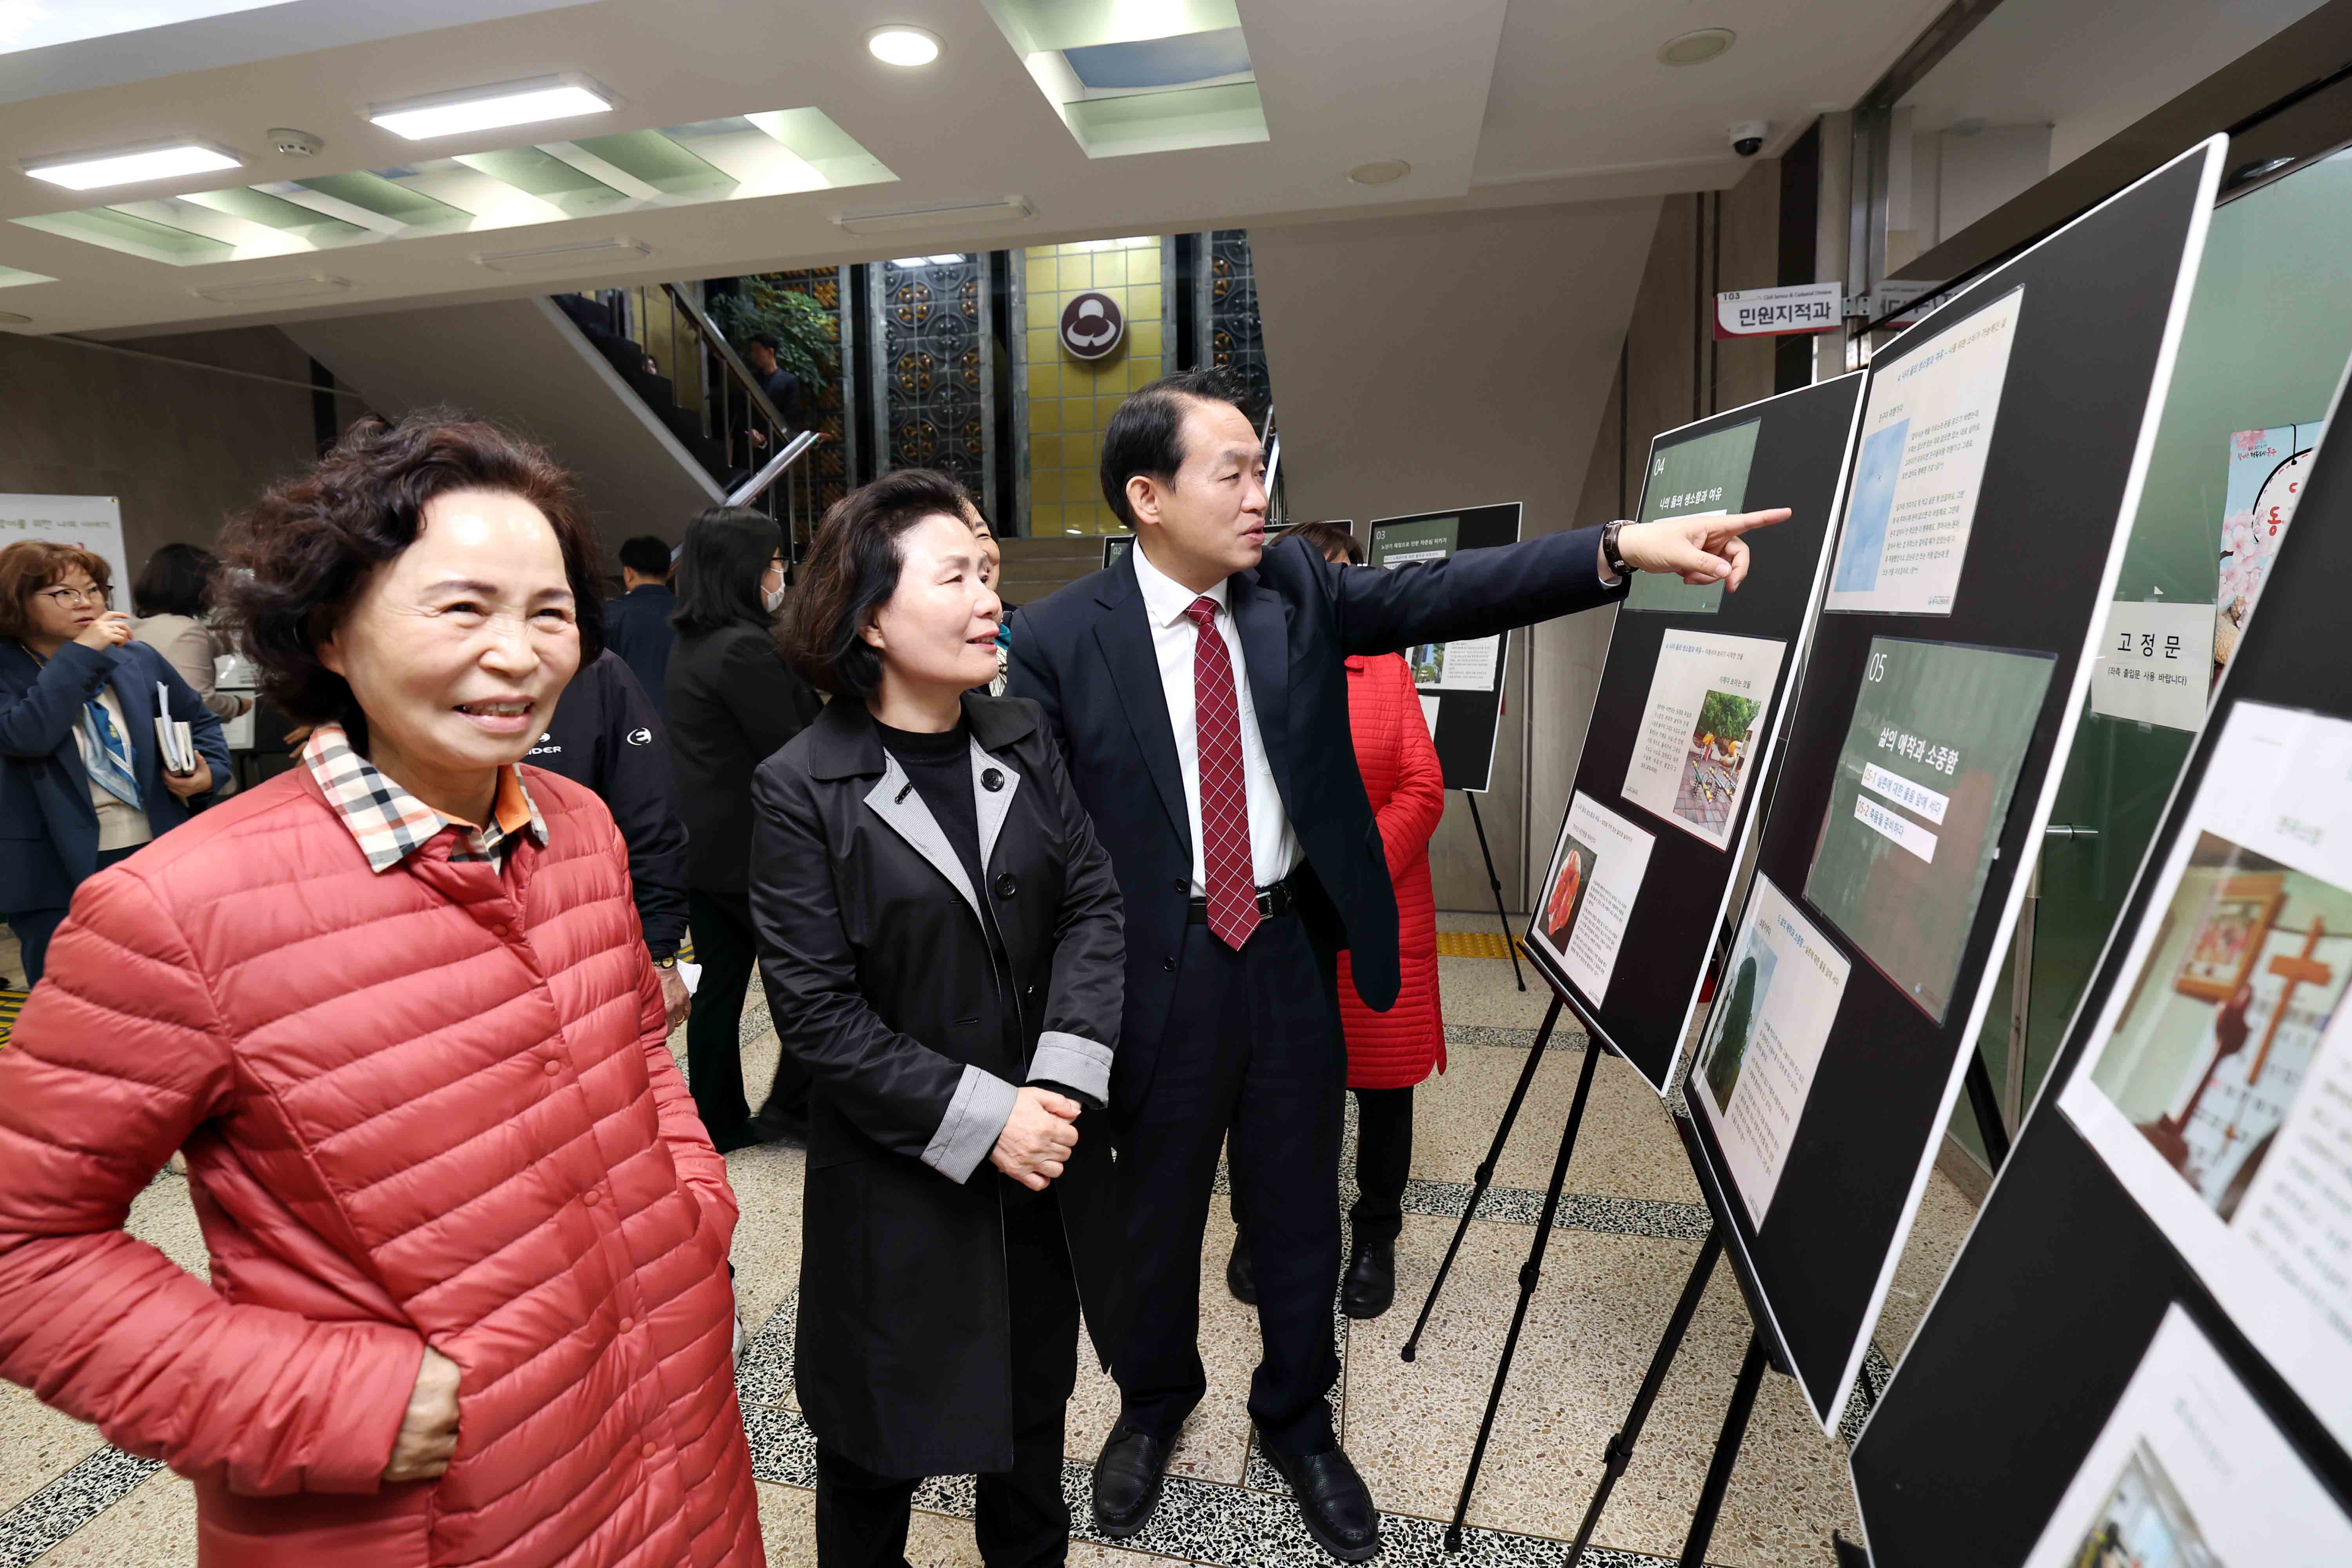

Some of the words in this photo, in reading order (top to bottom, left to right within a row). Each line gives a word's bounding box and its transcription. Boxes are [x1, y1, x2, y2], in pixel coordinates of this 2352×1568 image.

[1740, 301, 1831, 326] 민원지적과
[1654, 457, 1665, 476] 04
[1684, 490, 1708, 506] 생소함과
[1709, 487, 1722, 501] 여유
[1376, 530, 1386, 540] 03
[1113, 547, 1122, 555] 02
[1869, 653, 1887, 682] 05
[2123, 669, 2140, 679] 출입문
[2143, 671, 2155, 682] 사용
[2158, 673, 2187, 686] 바랍니다)
[1878, 728, 1897, 751] 삶의
[1898, 735, 1925, 761] 애착과
[1926, 746, 1958, 774] 소중함
[1864, 768, 1877, 782] 05-1
[1893, 782, 1904, 797] 대한
[1928, 800, 1942, 815] 서다
[1857, 800, 1869, 817] 05-2
[1870, 808, 1883, 826] 죽음을
[1884, 817, 1904, 835] 준비하다
